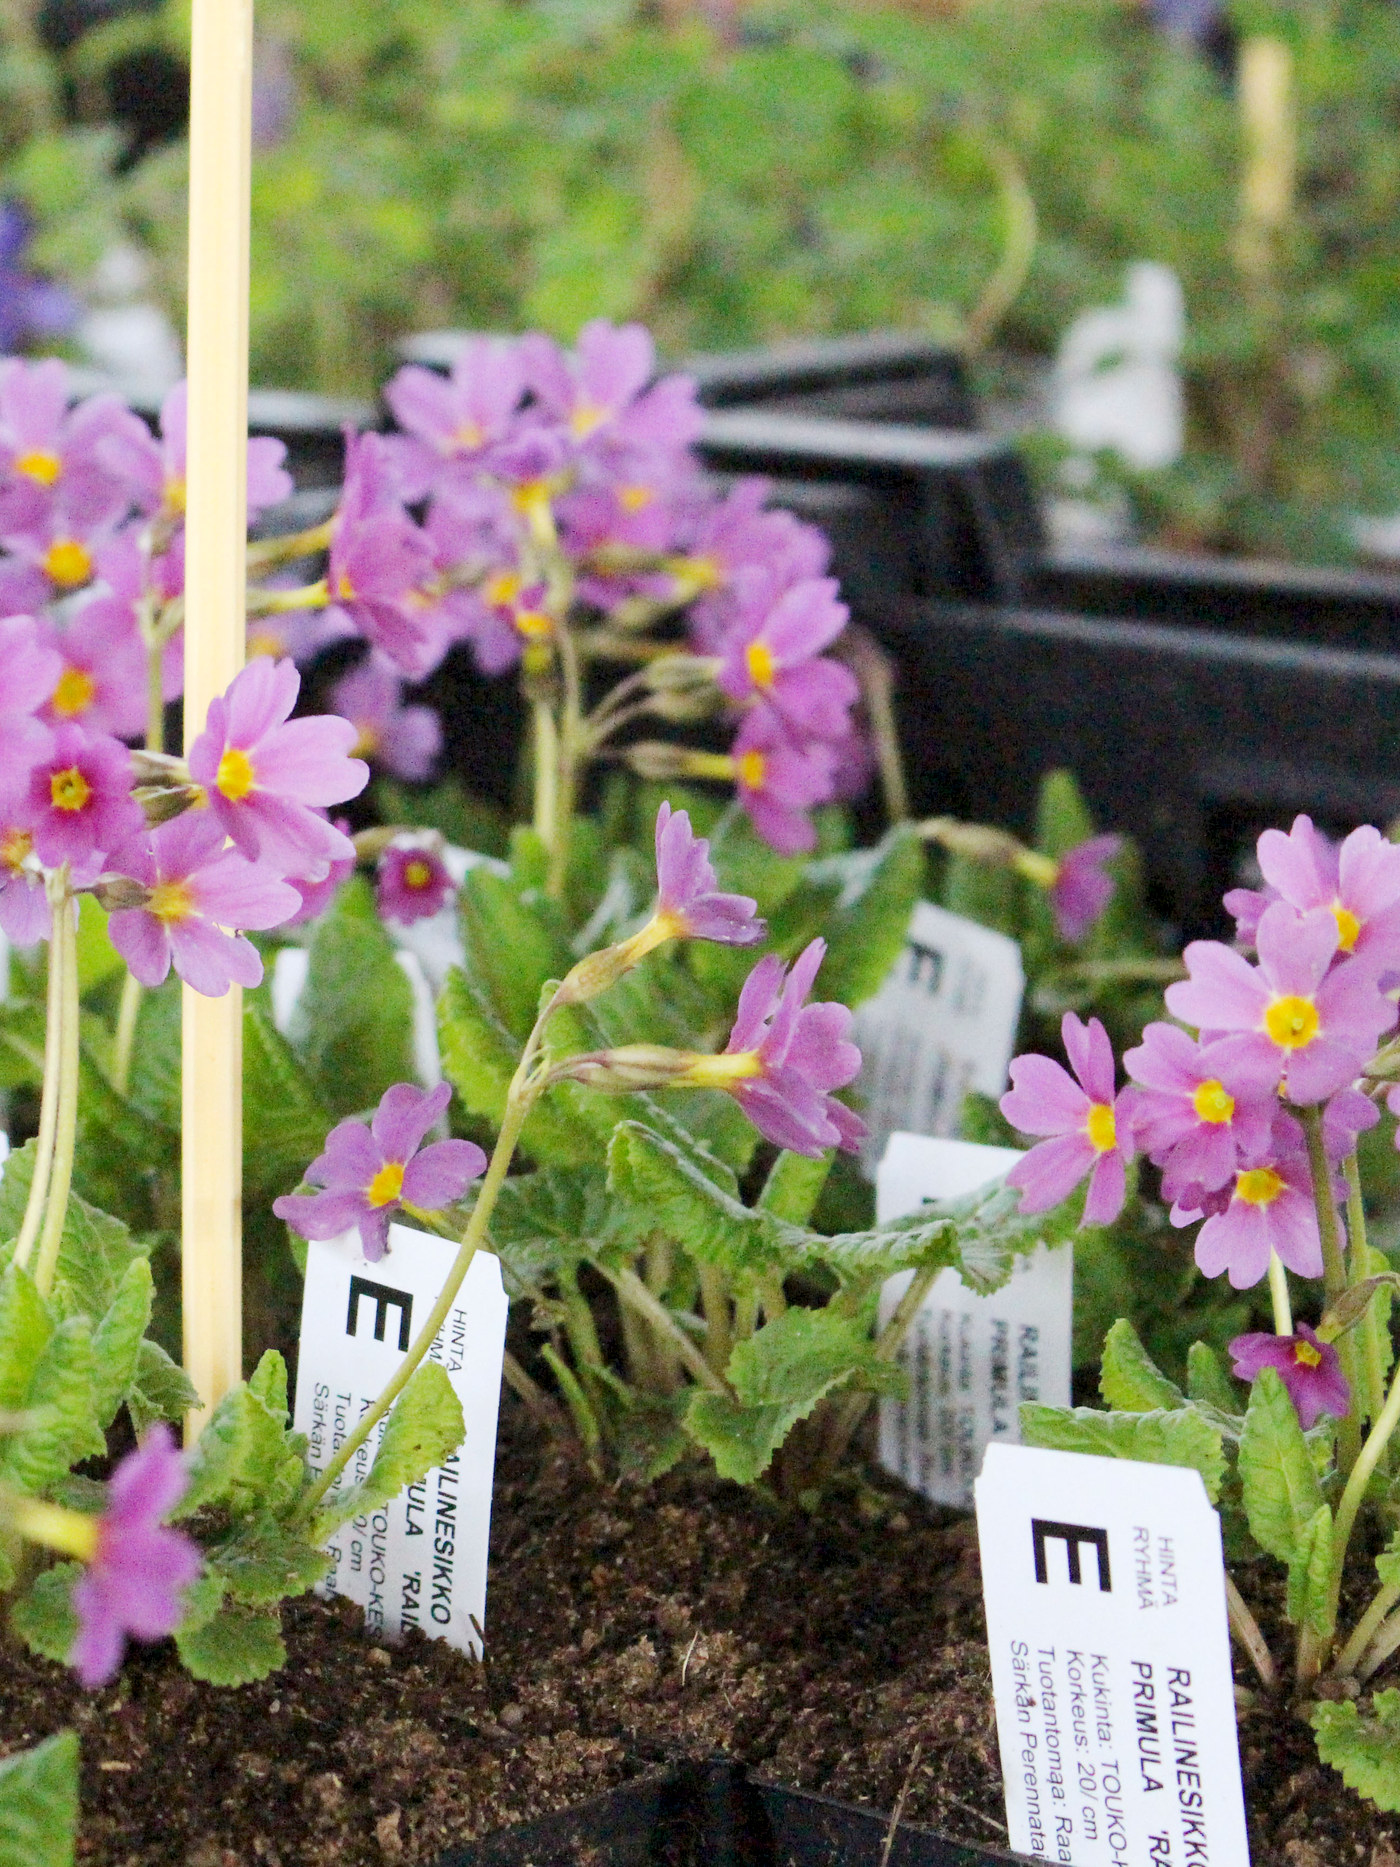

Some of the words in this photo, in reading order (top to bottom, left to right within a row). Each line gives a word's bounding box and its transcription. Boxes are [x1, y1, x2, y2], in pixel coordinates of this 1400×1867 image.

[345, 1274, 414, 1352] E
[448, 1308, 468, 1372] HINTA
[310, 1382, 330, 1458] Särkän
[350, 1540, 363, 1573] cm
[1031, 1518, 1112, 1592] E
[1132, 1525, 1160, 1610] RYHMÄ
[1156, 1536, 1179, 1607] HINTA
[1010, 1639, 1032, 1723] Särkän
[1065, 1649, 1090, 1754] Korkeus:
[1090, 1653, 1113, 1750] Kukinta:
[1036, 1645, 1067, 1807] Tuotantomaa:
[1130, 1659, 1165, 1793] PRIMULA
[1076, 1762, 1099, 1799] 20/
[1166, 1665, 1211, 1867] RAILINESIKK
[1081, 1807, 1099, 1841] cm
